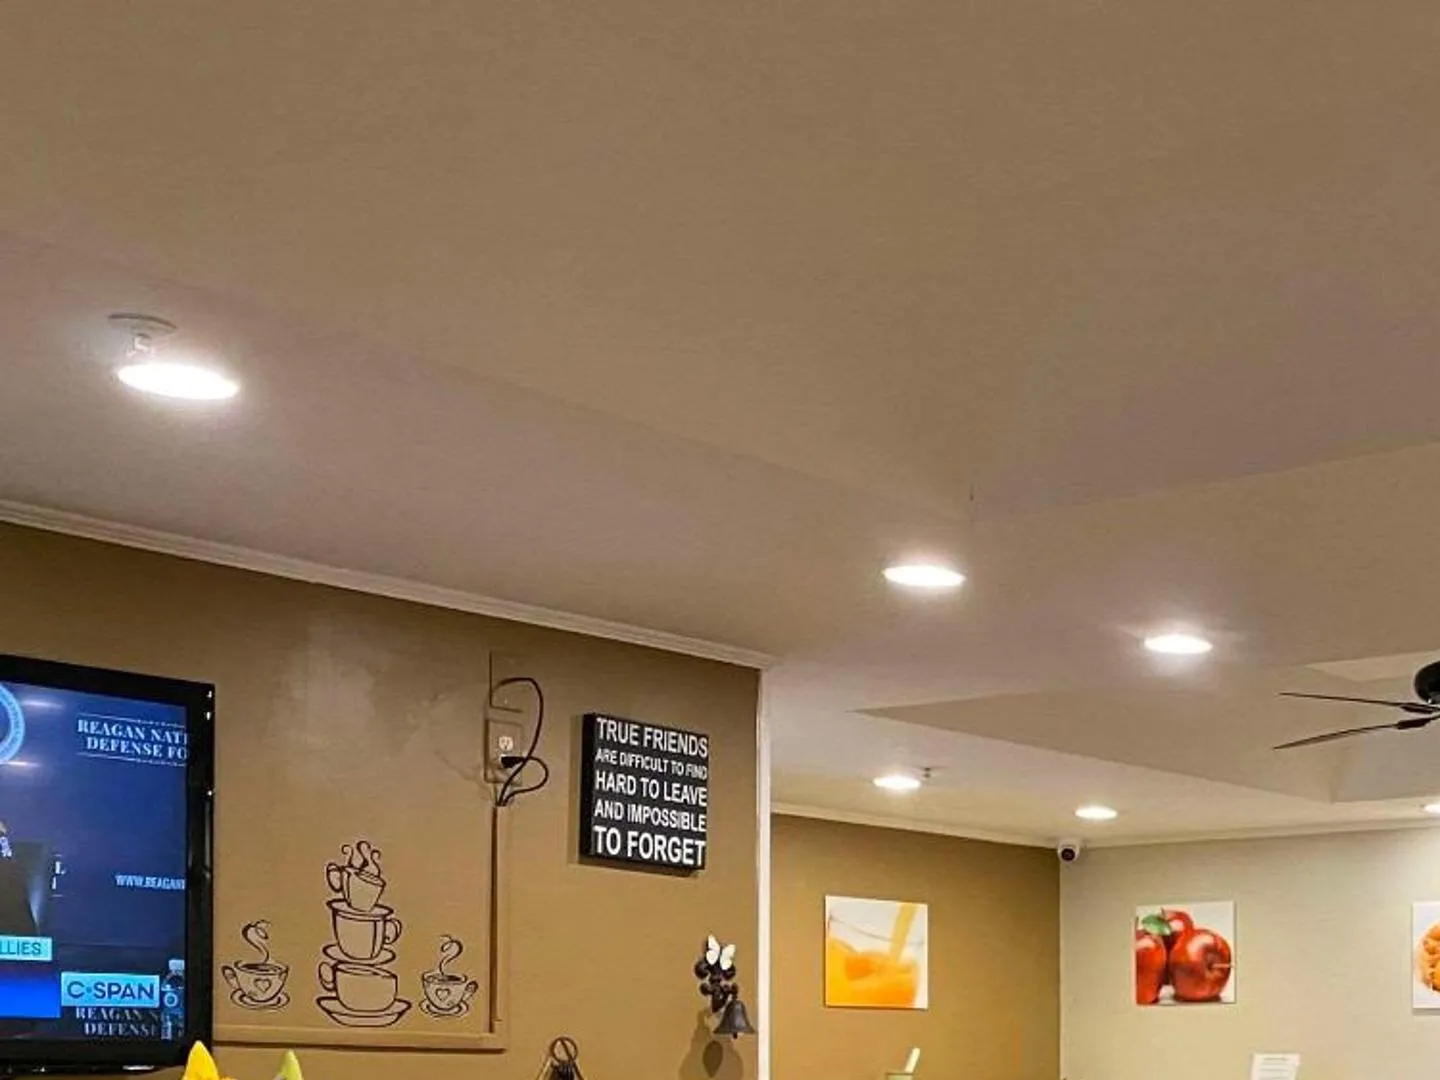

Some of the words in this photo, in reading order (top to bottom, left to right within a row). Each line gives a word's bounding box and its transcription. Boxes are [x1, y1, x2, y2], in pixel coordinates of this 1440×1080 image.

[78, 719, 146, 740] REAGAN
[86, 736, 162, 758] DEFENSE
[596, 717, 641, 746] TRUE
[643, 726, 708, 758] FRIENDS
[594, 748, 618, 765] ARE
[620, 751, 669, 774] DIFFICULT
[671, 760, 685, 776] TO
[686, 763, 708, 780] FIND
[595, 770, 637, 796] HARD
[639, 777, 660, 800] TO
[663, 781, 708, 807] LEAVE
[594, 798, 625, 821] AND
[627, 803, 708, 833] IMPOSSIBLE
[592, 825, 621, 856] TO
[627, 830, 707, 866] FORGET
